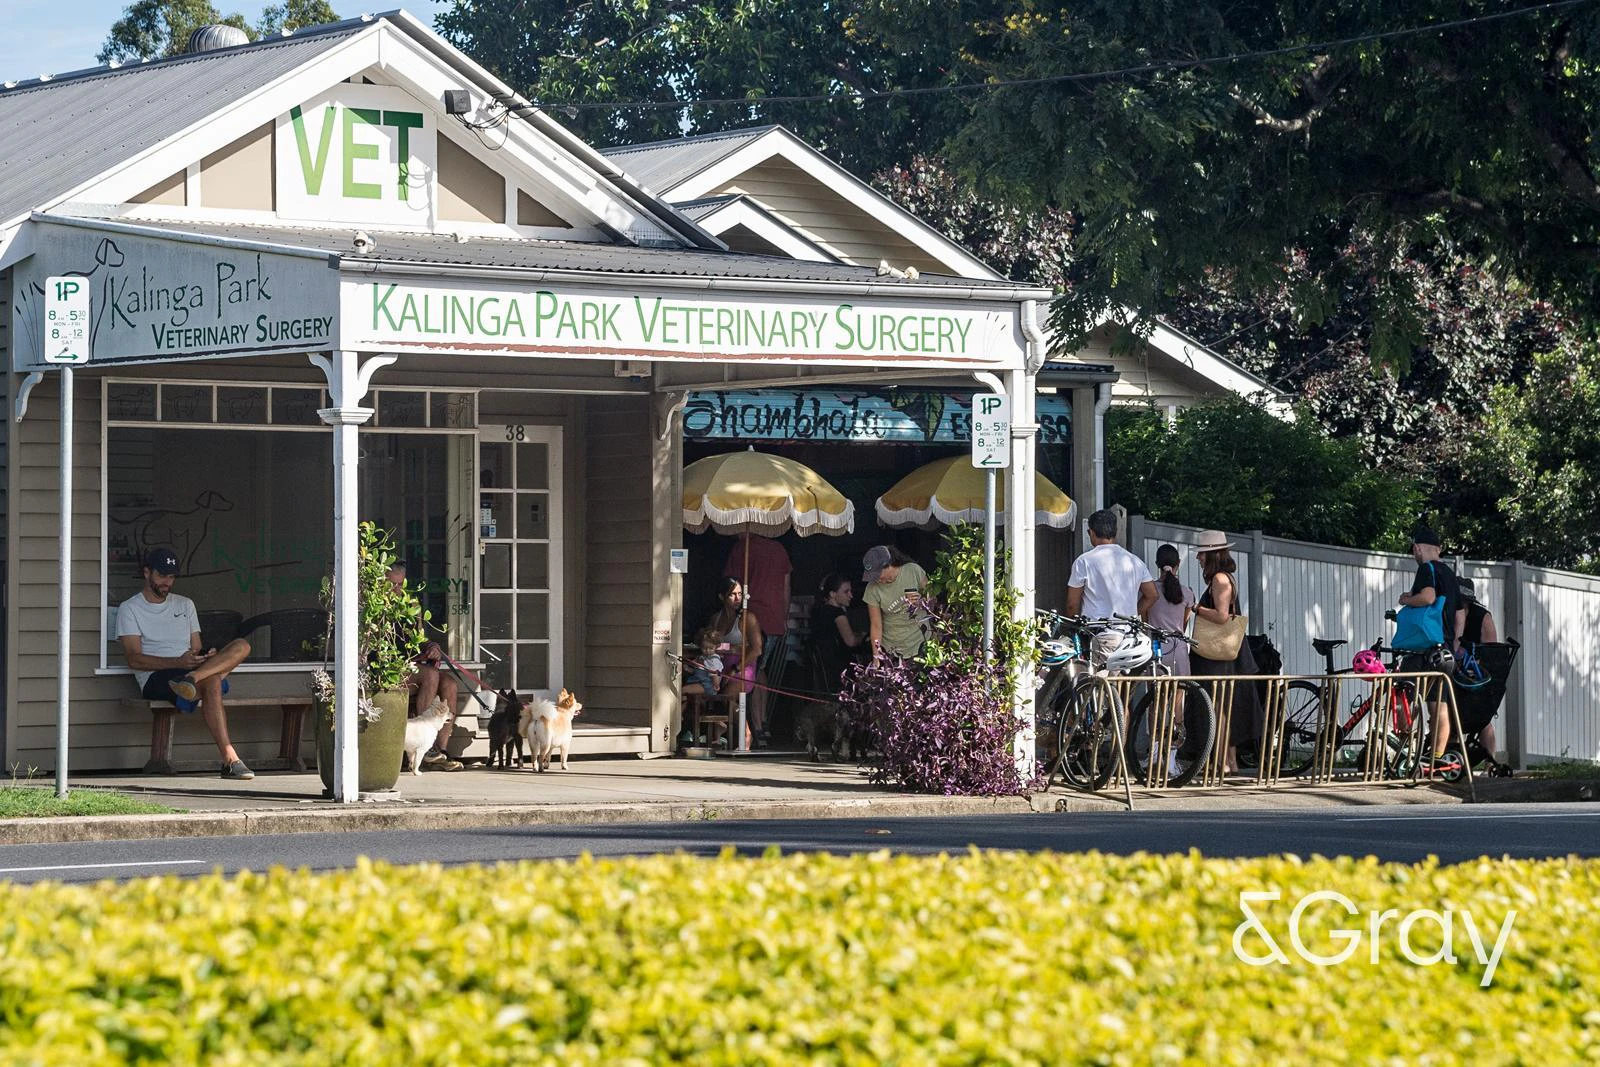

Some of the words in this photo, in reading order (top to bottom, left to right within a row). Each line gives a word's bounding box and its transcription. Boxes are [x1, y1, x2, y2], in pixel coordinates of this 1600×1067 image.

[290, 104, 424, 201] VET
[55, 282, 80, 301] 1P
[111, 266, 204, 329] Kalinga
[217, 253, 272, 318] Park
[152, 322, 249, 350] VETERINARY
[256, 314, 333, 343] SURGERY
[372, 283, 526, 338] KALINGA
[535, 290, 622, 342] PARK
[634, 295, 828, 349] VETERINARY
[835, 304, 973, 353] SURGERY
[980, 397, 1002, 415] 1P
[505, 424, 525, 441] 38
